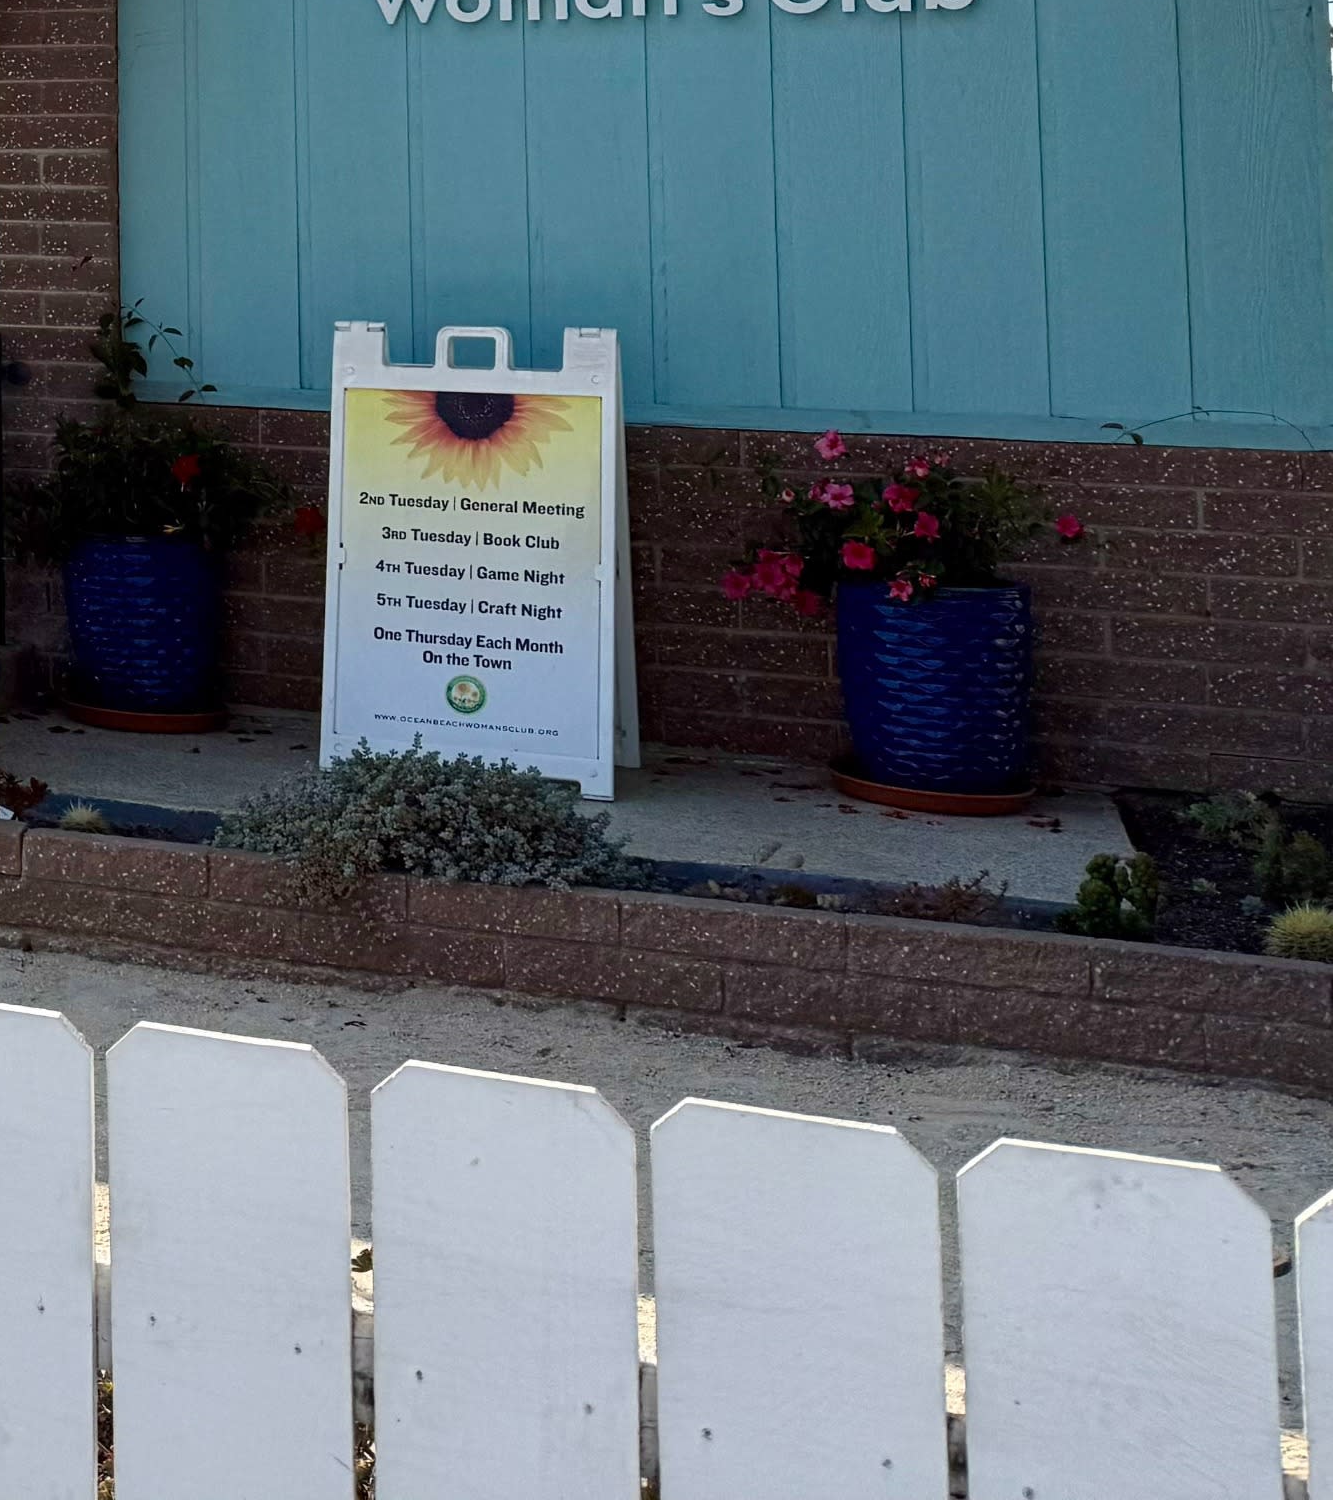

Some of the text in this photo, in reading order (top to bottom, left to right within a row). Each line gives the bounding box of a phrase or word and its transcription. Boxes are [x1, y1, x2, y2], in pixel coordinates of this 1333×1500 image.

[360, 492, 384, 505] 2ND
[389, 494, 449, 511] Tuesday
[461, 498, 517, 513] General
[523, 501, 585, 519] Meeting
[382, 527, 406, 540] 3RD
[411, 529, 471, 546] Tuesday
[484, 533, 521, 547] Book
[526, 536, 559, 549] Club
[376, 560, 400, 573] 4TH
[405, 561, 465, 579] Tuesday
[477, 567, 519, 581] Game
[524, 569, 565, 585] Night
[377, 593, 401, 607] 5TH
[406, 595, 466, 614] Tuesday
[478, 601, 517, 616] Craft
[521, 604, 562, 620] Night
[374, 627, 563, 654] One Thursday Each Month
[423, 651, 512, 670] On the Town
